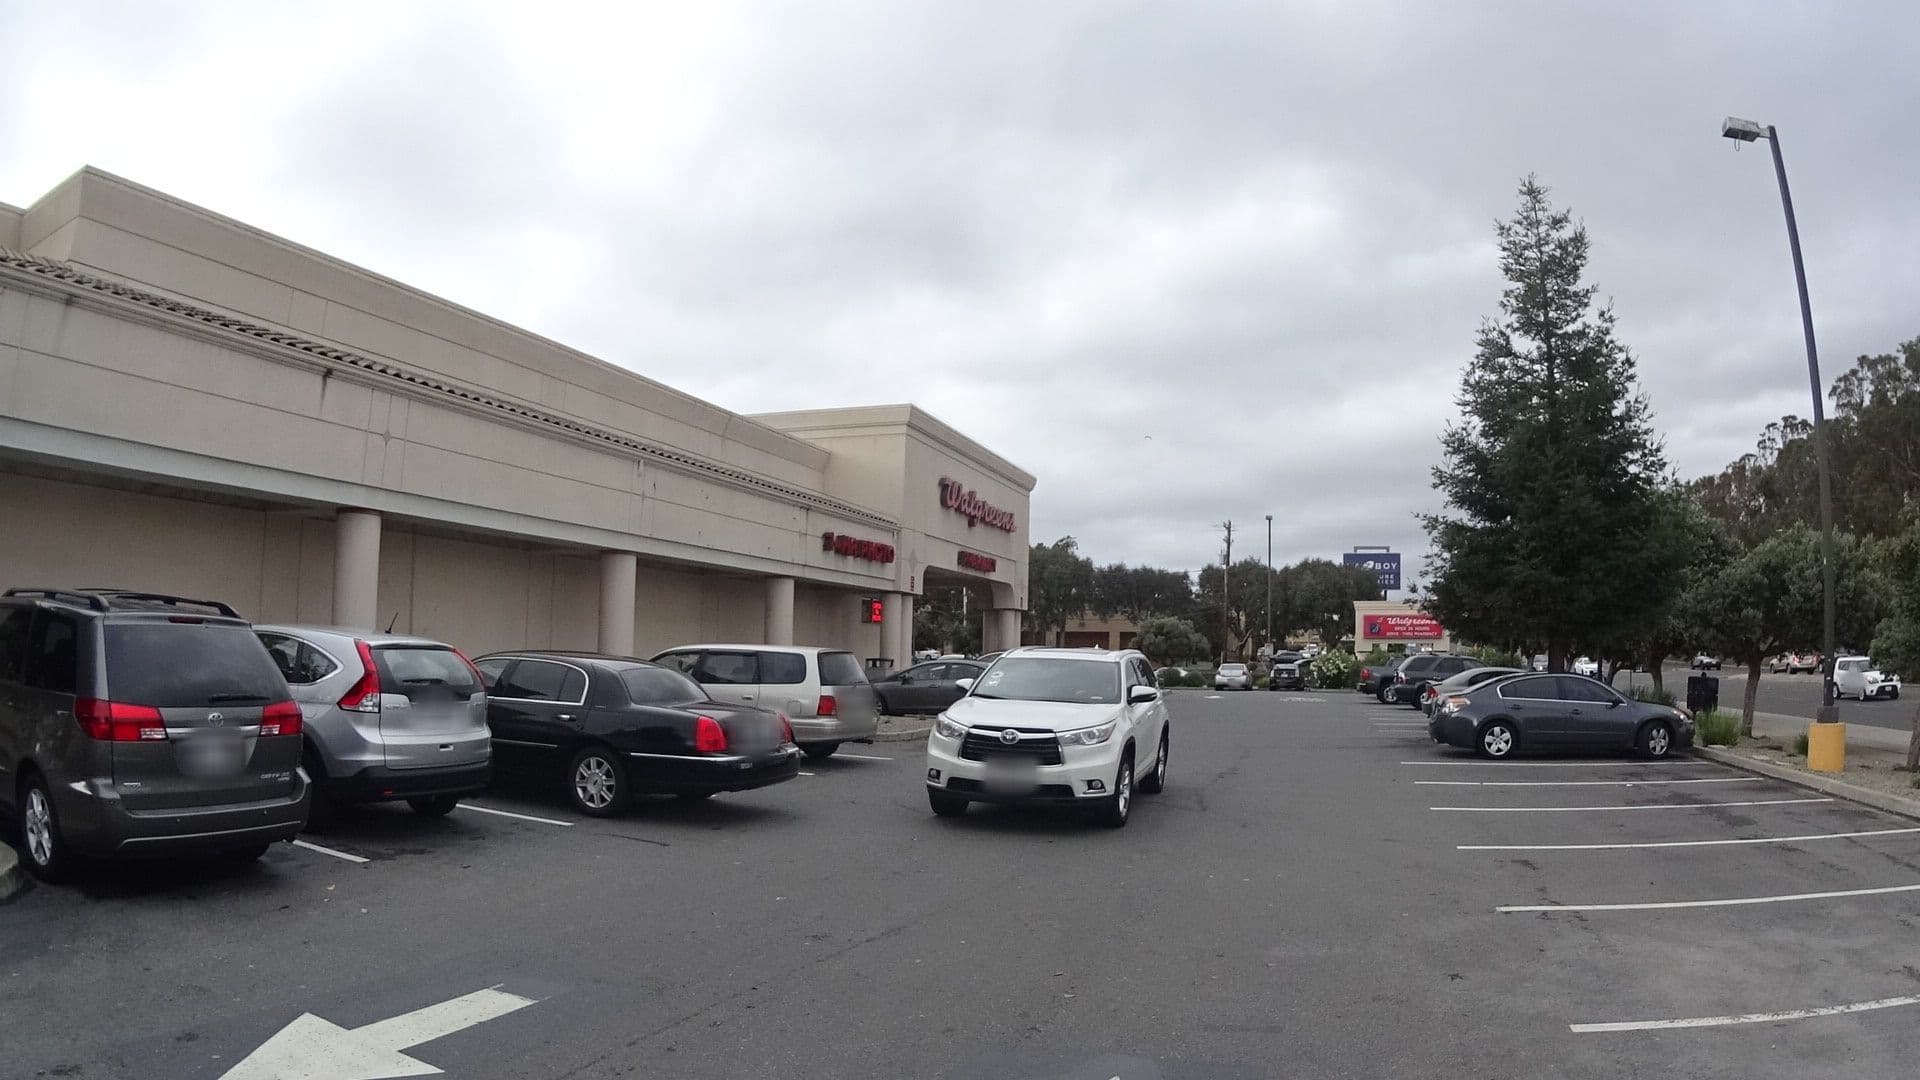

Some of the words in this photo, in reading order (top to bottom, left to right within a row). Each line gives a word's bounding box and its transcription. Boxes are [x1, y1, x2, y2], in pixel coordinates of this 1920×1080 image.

[938, 477, 1016, 533] Walgreens
[1375, 562, 1398, 570] BOY
[1386, 616, 1438, 627] Walgreens
